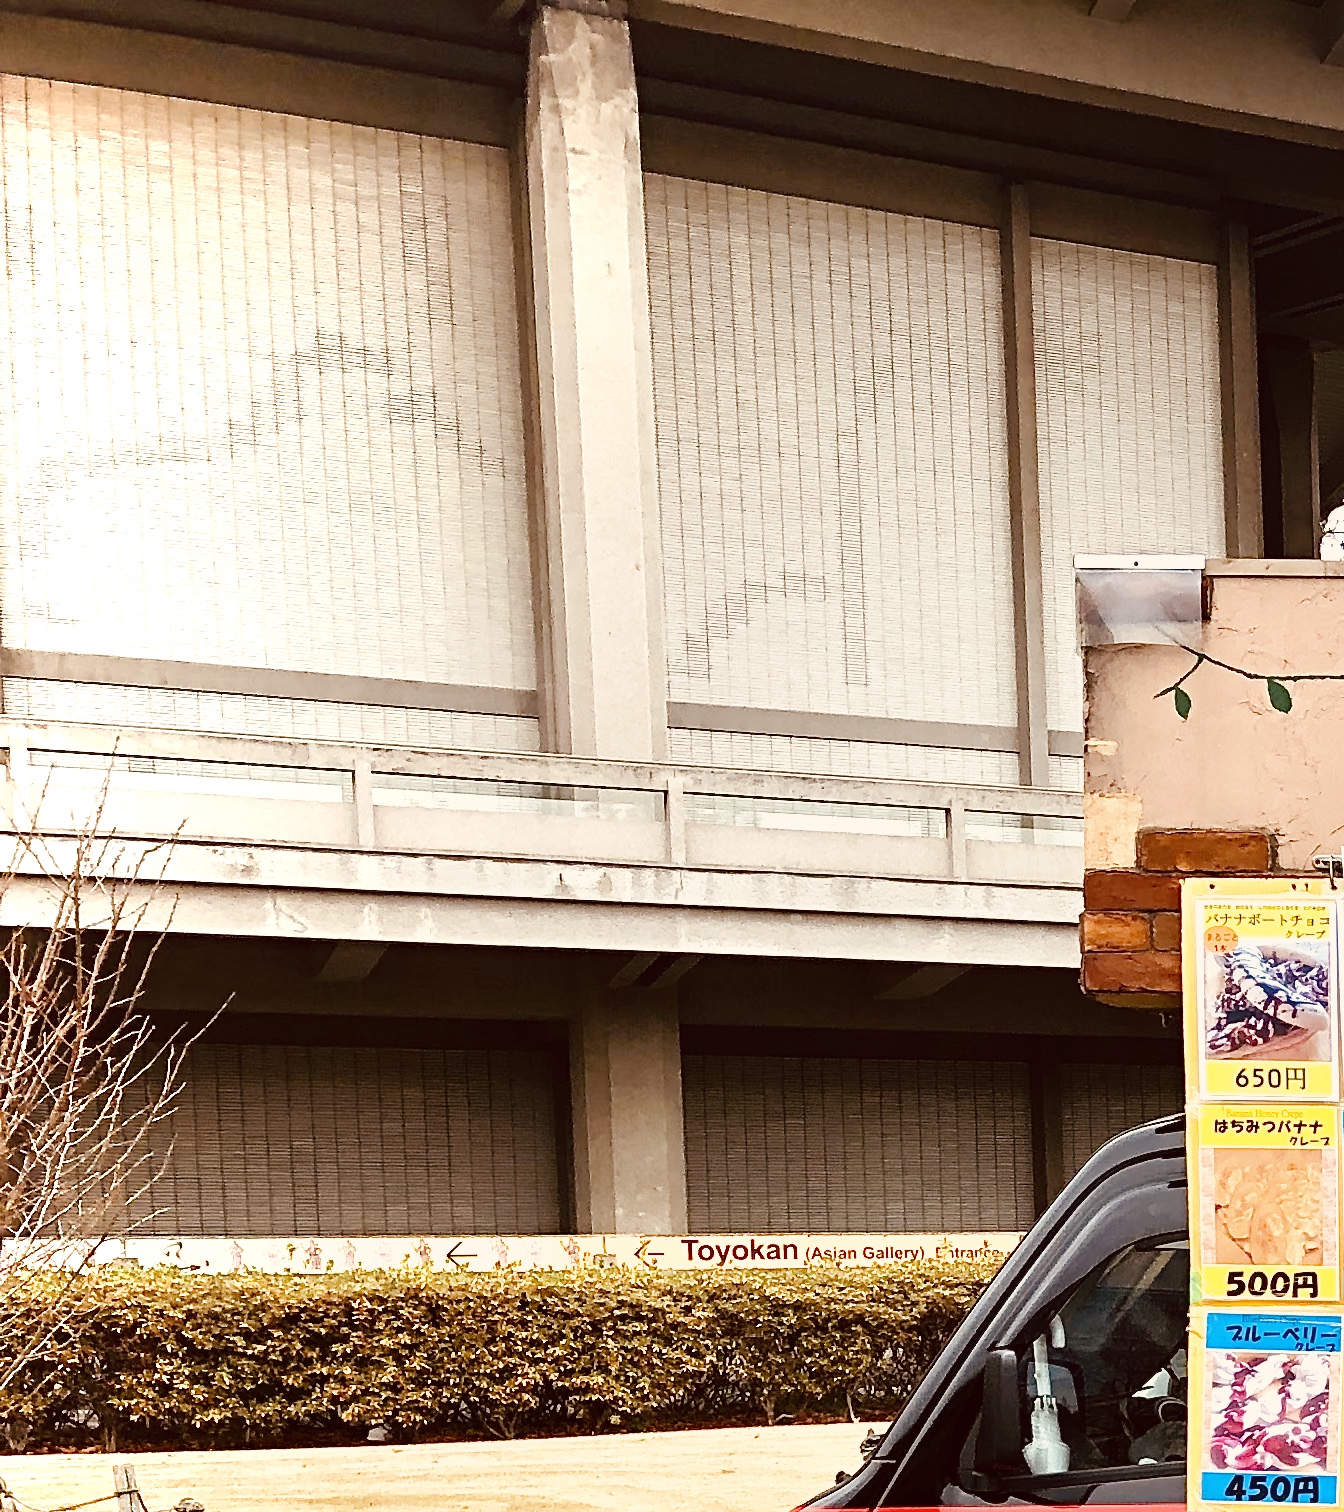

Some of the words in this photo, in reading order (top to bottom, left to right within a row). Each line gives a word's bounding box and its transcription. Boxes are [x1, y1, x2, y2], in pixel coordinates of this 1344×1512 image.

[1205, 914, 1330, 926] バナナボートチョコ
[1285, 929, 1326, 939] クレープ
[1235, 1067, 1306, 1090] 650円
[1214, 1119, 1323, 1134] はちみつバナナ
[1289, 1137, 1330, 1146] クレープ
[682, 1239, 799, 1265] Toyokan
[805, 1246, 857, 1260] (Asian
[862, 1246, 925, 1261] Gallery)
[1226, 1271, 1319, 1299] 500円
[1226, 1326, 1338, 1344] ブルーベリー
[1294, 1343, 1336, 1352] クレープ
[1225, 1475, 1320, 1503] 450円
